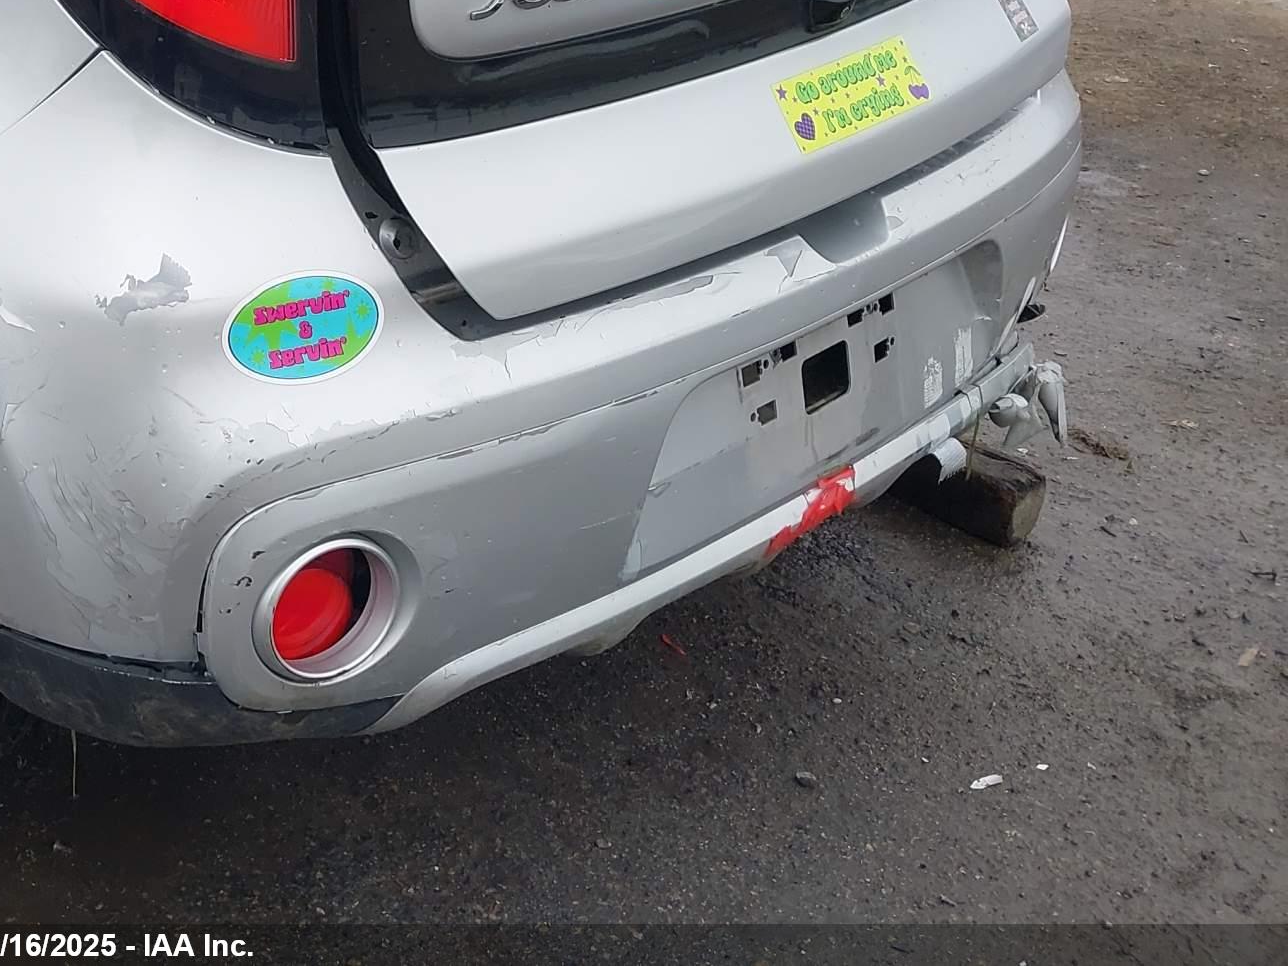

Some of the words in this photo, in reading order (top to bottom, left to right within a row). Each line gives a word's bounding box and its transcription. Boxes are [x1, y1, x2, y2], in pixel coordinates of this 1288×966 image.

[795, 81, 820, 105] Go
[818, 53, 877, 96] around
[849, 82, 905, 122] crying
[253, 289, 350, 326] Swervin'
[299, 320, 313, 340] &
[268, 336, 347, 370] Servin'
